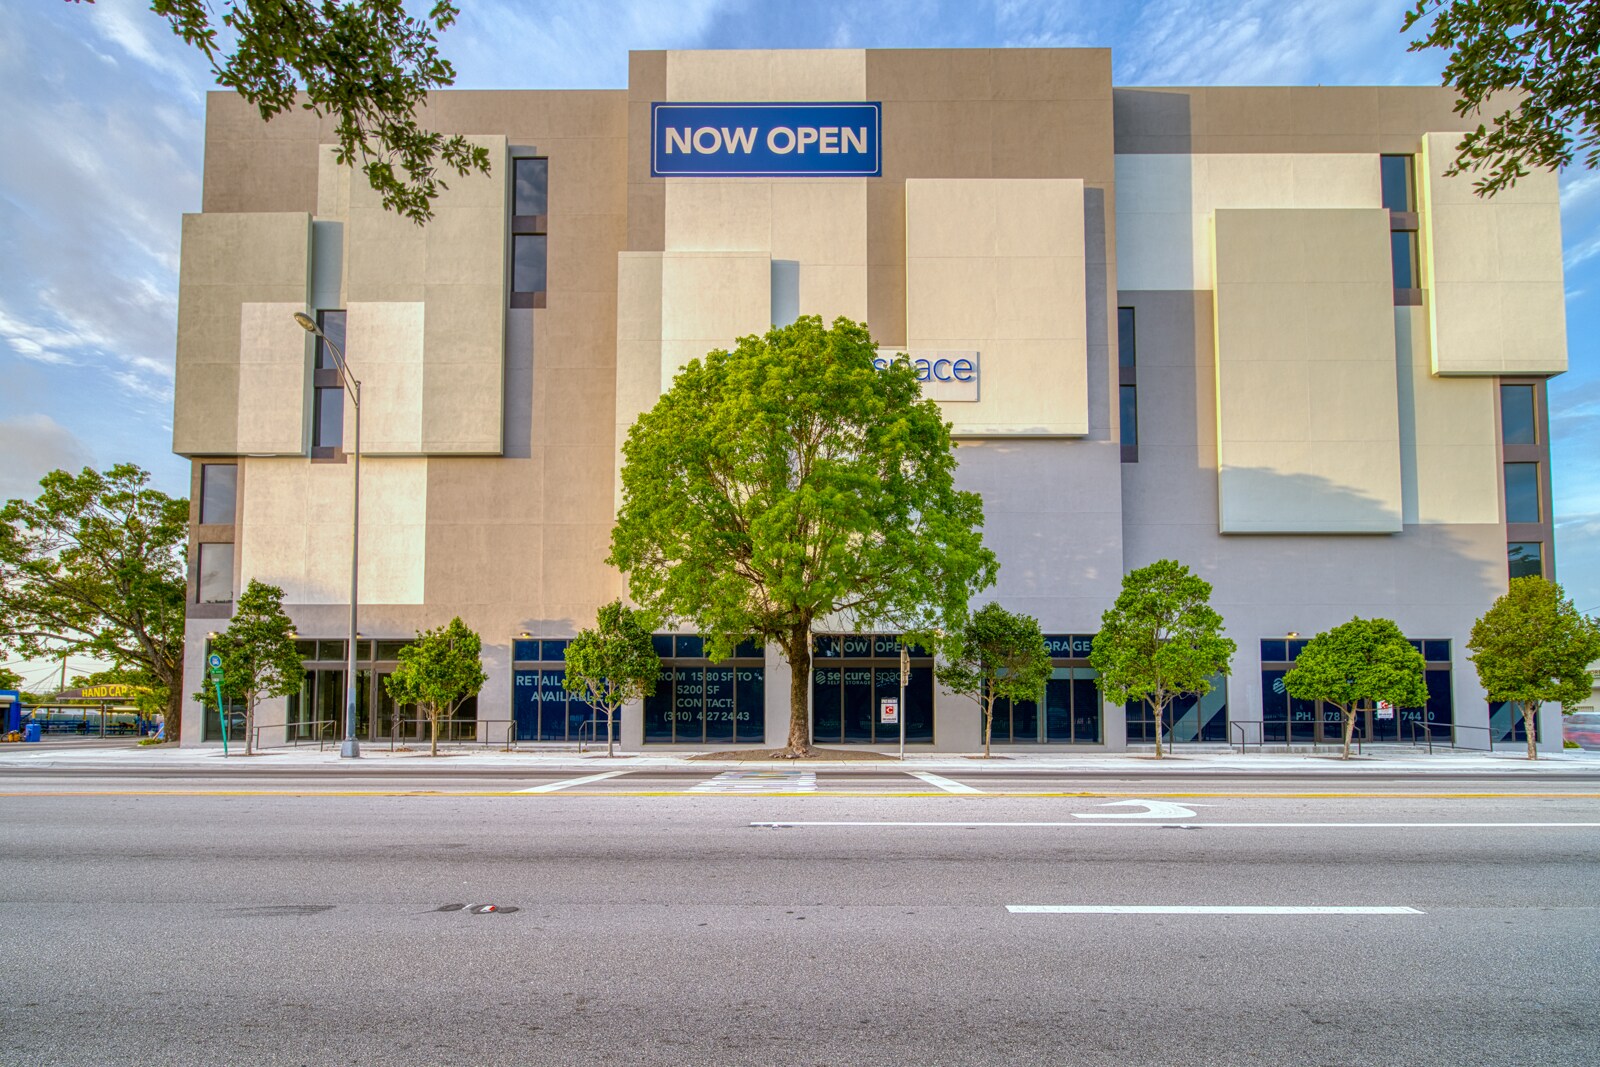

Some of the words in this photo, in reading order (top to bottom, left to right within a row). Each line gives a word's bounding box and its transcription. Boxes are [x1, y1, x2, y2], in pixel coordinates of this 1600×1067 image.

[665, 126, 758, 154] NOW
[766, 126, 868, 154] OPEN
[873, 358, 973, 381] sace
[830, 641, 868, 653] NOW
[1043, 641, 1091, 651] ORAGE
[516, 675, 561, 686] RETAIL
[657, 672, 686, 681] ROM
[691, 672, 719, 681] 1580
[721, 672, 734, 681] SF
[737, 672, 752, 681] TO
[827, 671, 871, 680] secure
[81, 685, 108, 698] HAND
[677, 686, 703, 694] 5200
[707, 686, 720, 694] SF
[663, 711, 692, 722] (310)
[1296, 711, 1315, 721] PH.
[1324, 711, 1358, 721] (78)
